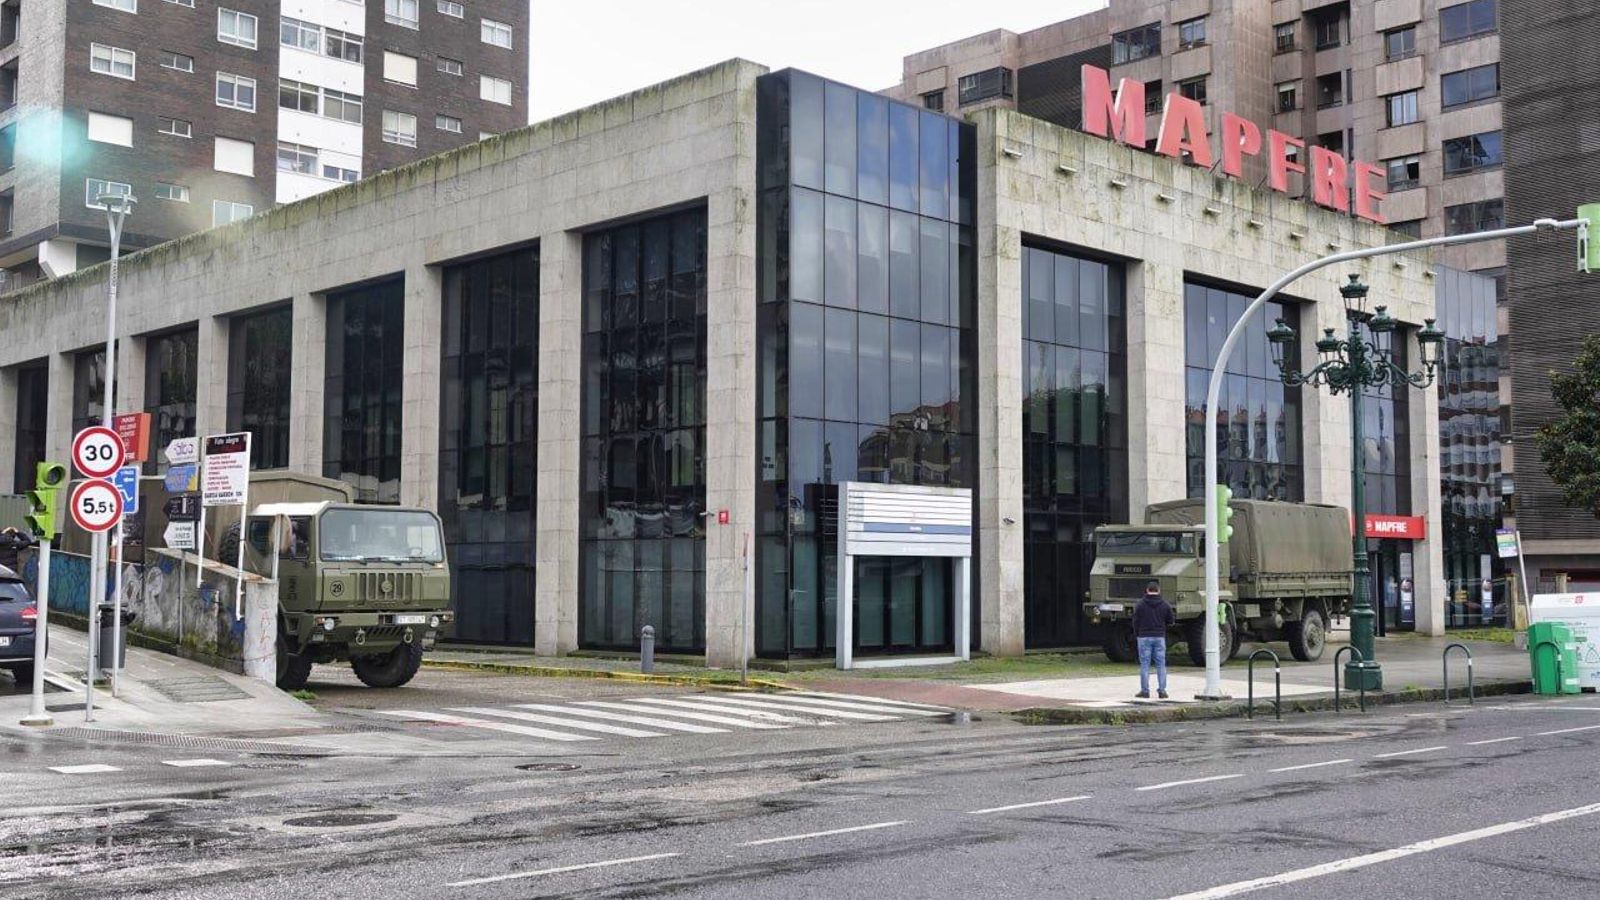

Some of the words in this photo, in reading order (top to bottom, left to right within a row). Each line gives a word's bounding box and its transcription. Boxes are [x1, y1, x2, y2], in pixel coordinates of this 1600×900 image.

[1081, 64, 1387, 225] MAPFRE
[85, 444, 113, 461] 30
[1375, 521, 1407, 533] MAPFRE
[333, 584, 342, 593] 29
